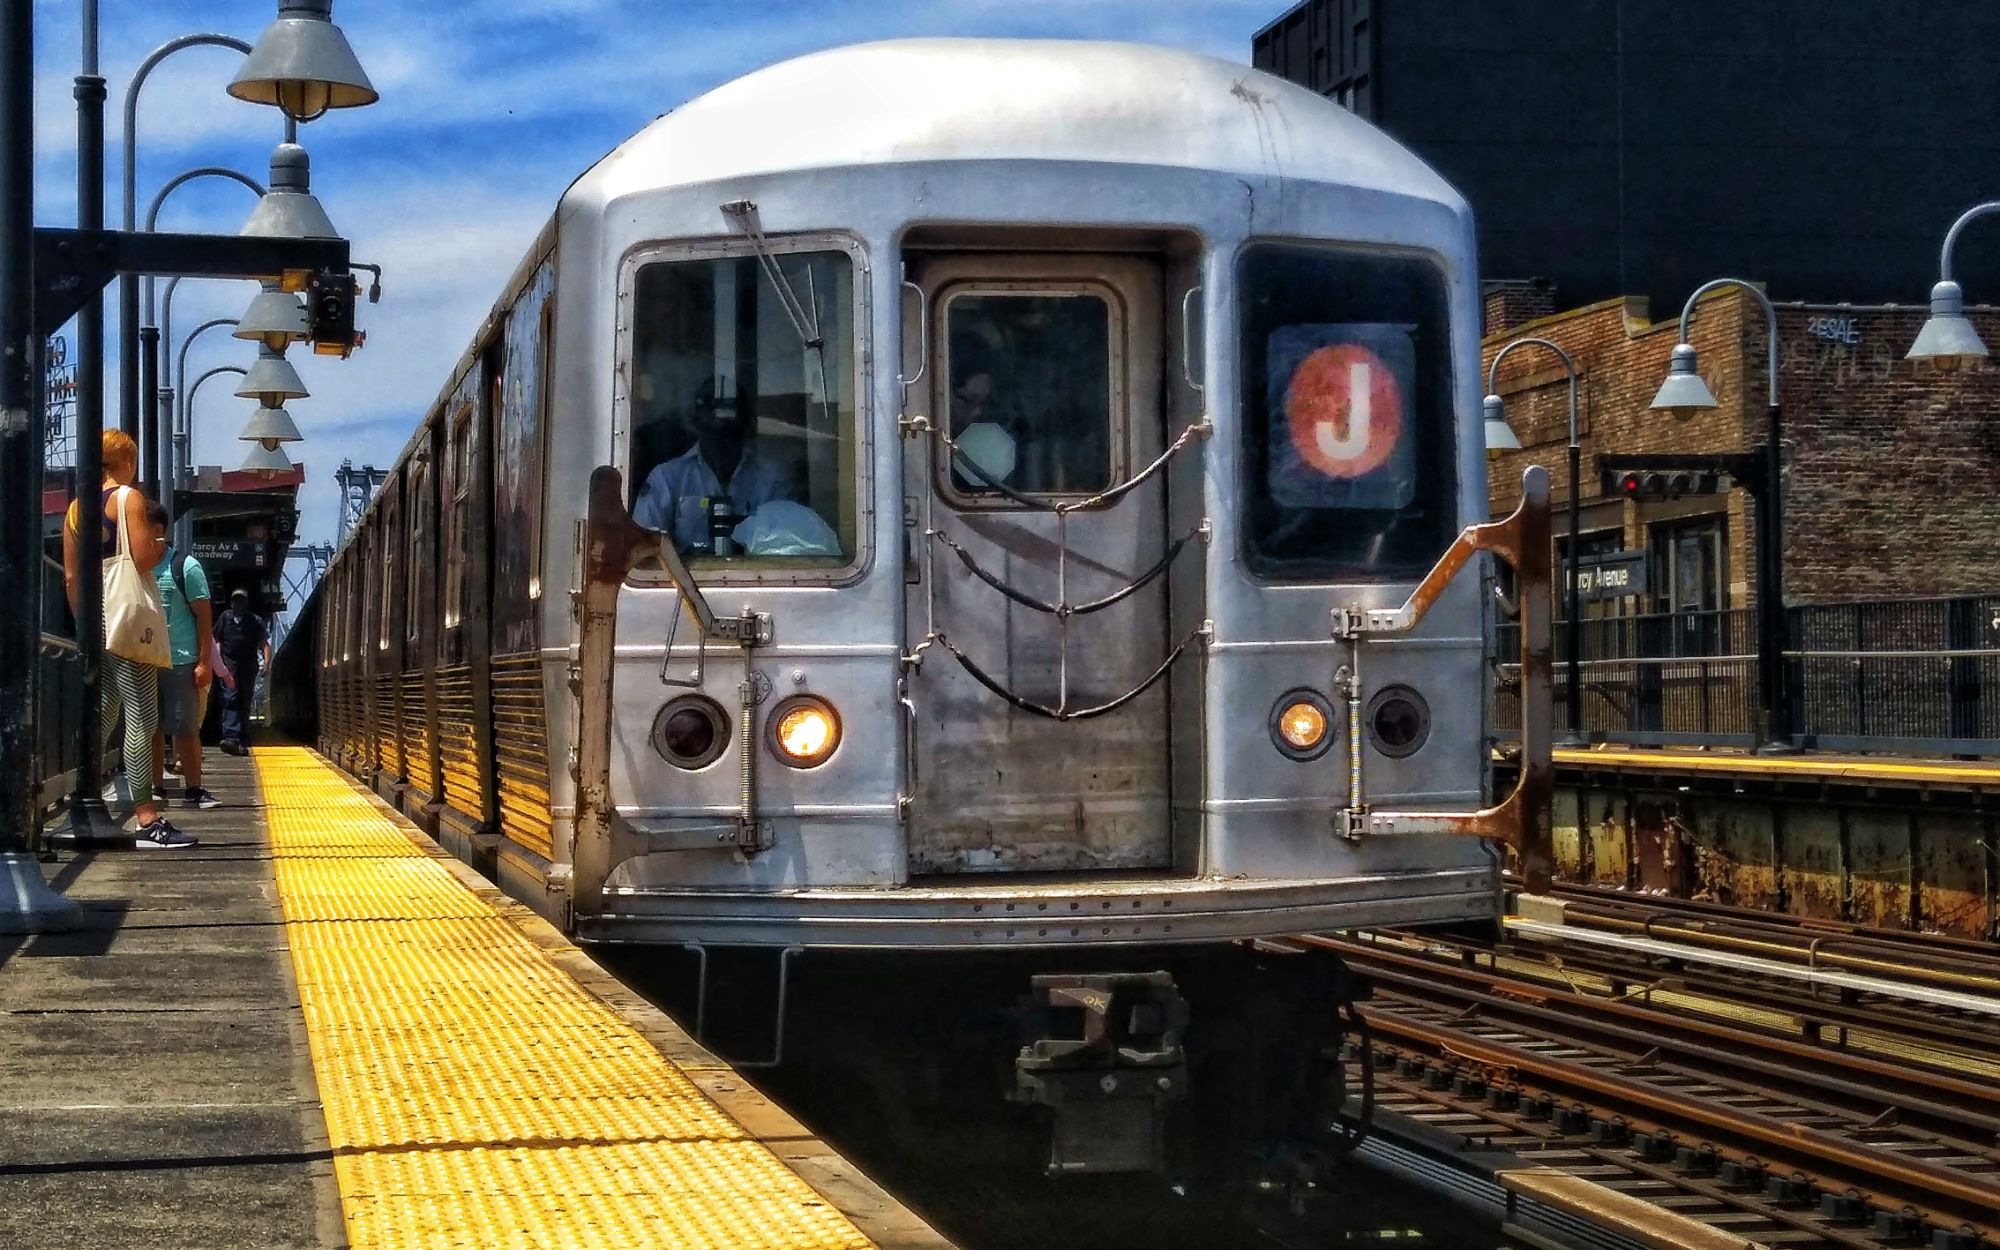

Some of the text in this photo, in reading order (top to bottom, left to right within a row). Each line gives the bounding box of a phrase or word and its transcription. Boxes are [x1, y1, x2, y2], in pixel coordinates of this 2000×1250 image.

[1316, 362, 1371, 460] J
[218, 543, 231, 551] Av
[232, 543, 239, 551] &
[1566, 566, 1629, 593] rcy Avenue
